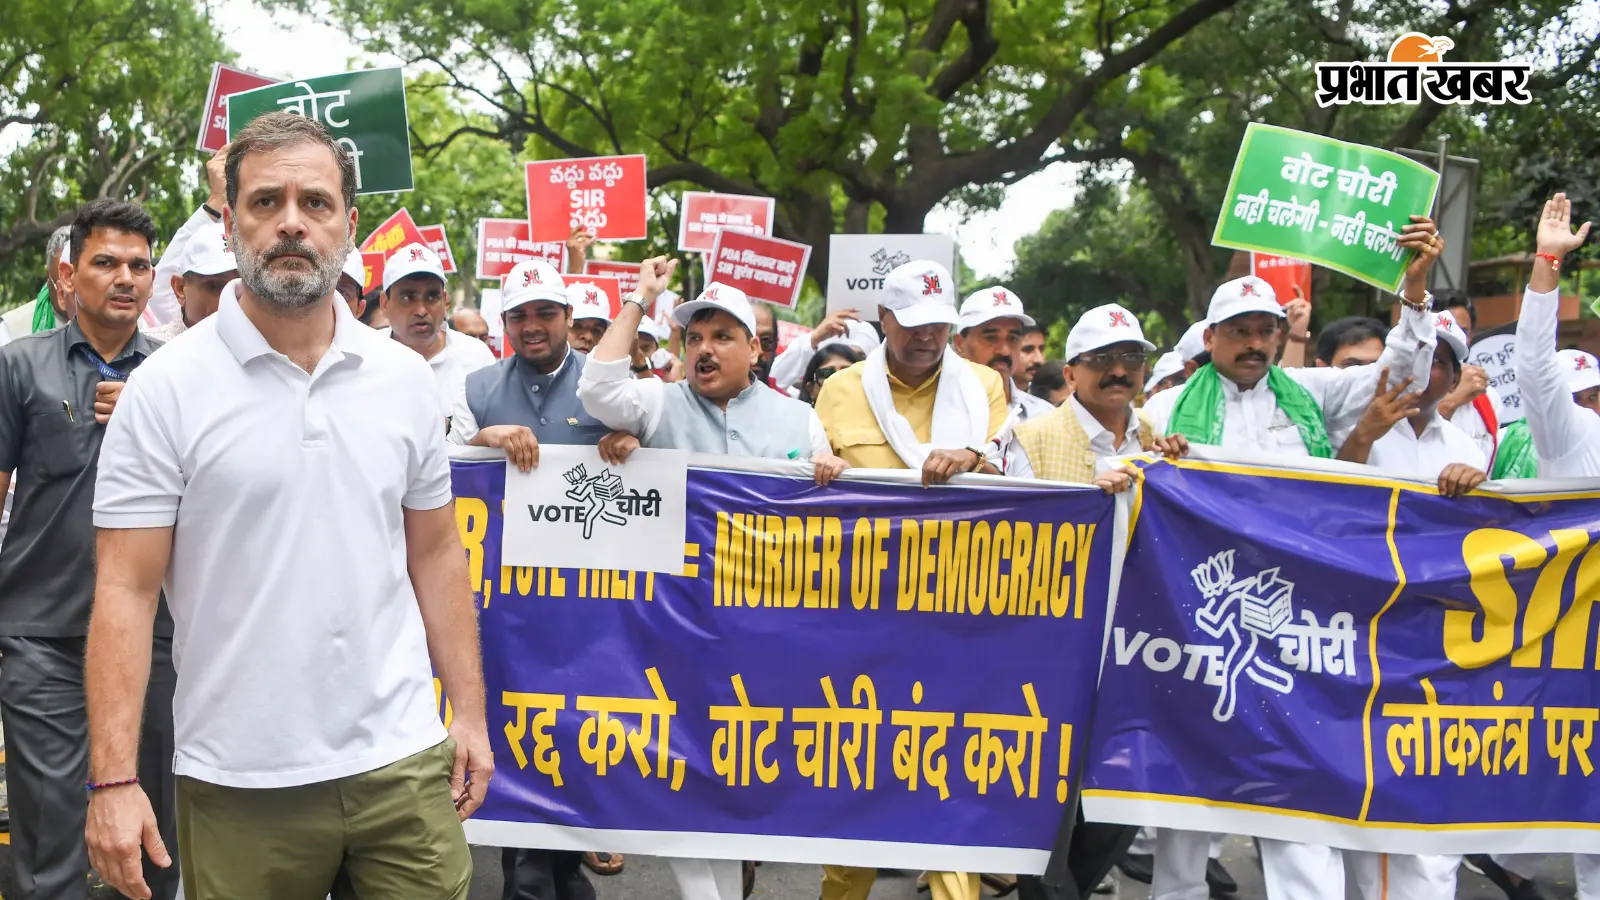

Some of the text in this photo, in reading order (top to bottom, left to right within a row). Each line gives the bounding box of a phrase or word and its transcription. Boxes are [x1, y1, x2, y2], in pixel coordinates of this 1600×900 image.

[213, 115, 228, 130] SI
[569, 189, 606, 209] SIR
[1280, 151, 1398, 207] वोट चोरी
[1267, 195, 1320, 233] चलेगी
[846, 278, 885, 290] VOTE
[527, 488, 662, 523] VOTE चोरी
[713, 511, 843, 610] MURDER
[850, 516, 891, 611] OF
[896, 518, 1097, 619] DEMOCRACY
[1113, 608, 1358, 687] VOTE चोरी
[501, 690, 566, 787] रद्द
[575, 666, 687, 792] करो,
[708, 673, 784, 787] वोट
[792, 674, 882, 791] चोरी
[890, 680, 955, 801] बंद
[963, 682, 1048, 799] करो
[1382, 677, 1600, 777] लोकतंत्र पर
